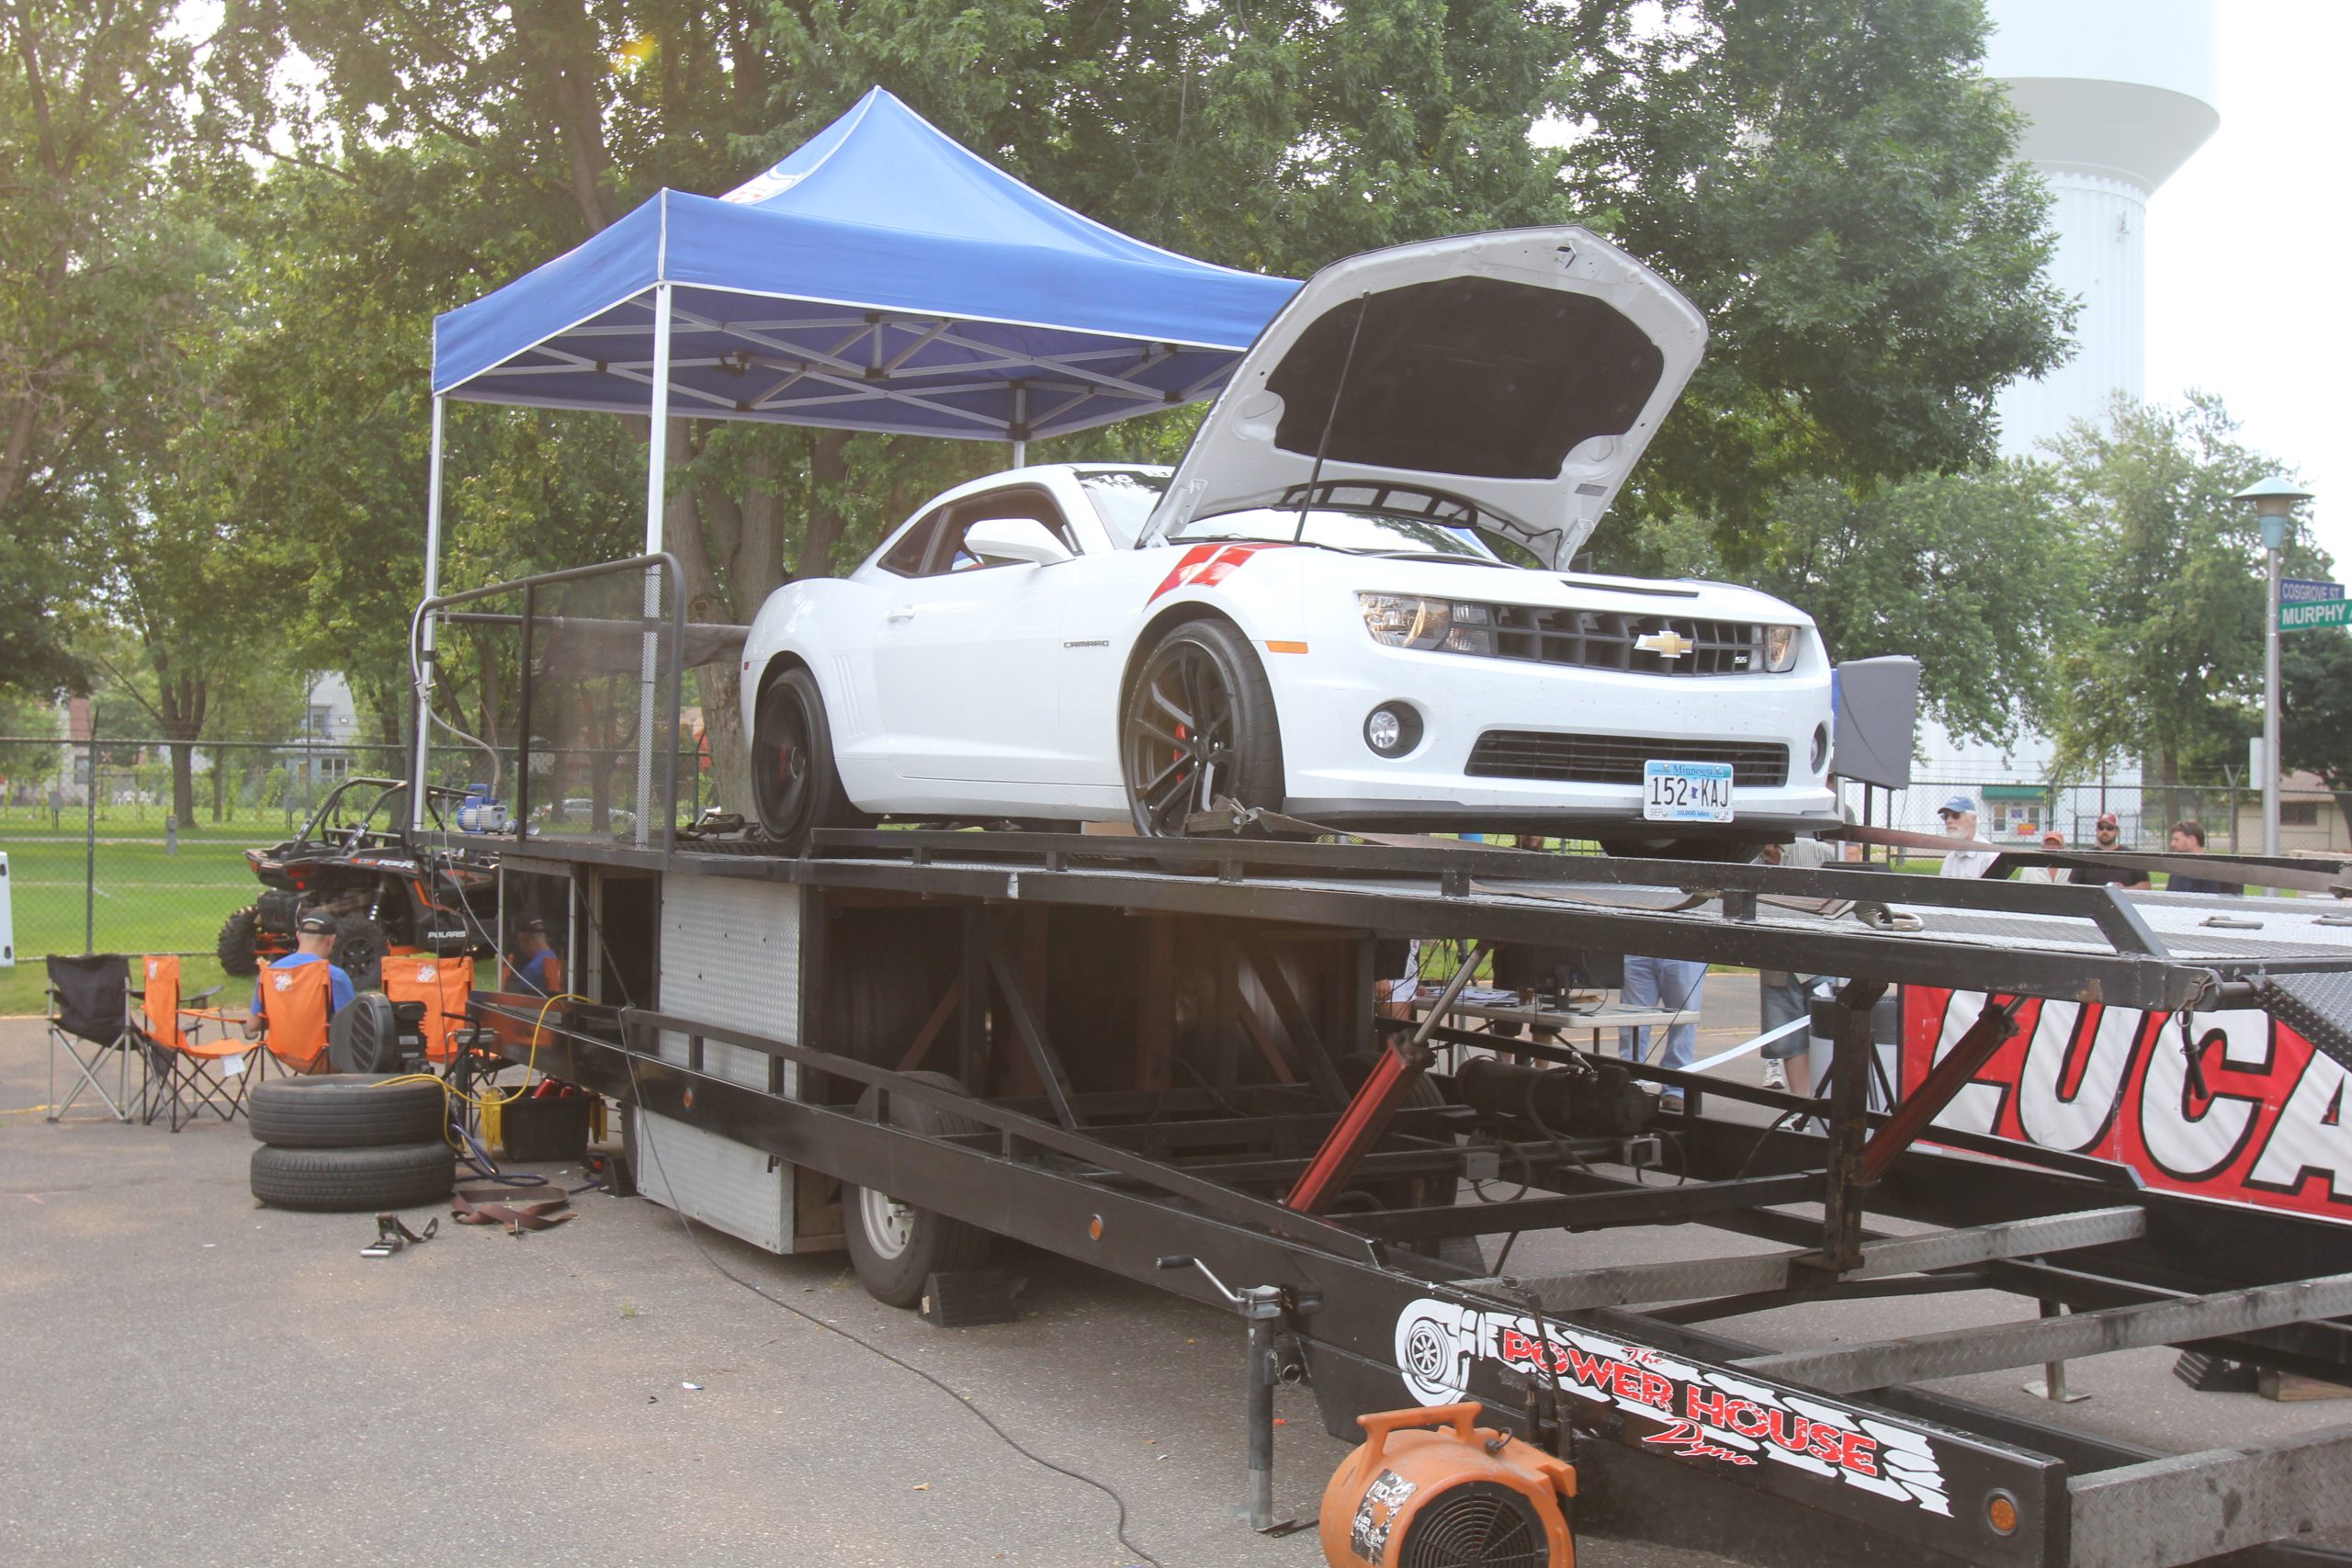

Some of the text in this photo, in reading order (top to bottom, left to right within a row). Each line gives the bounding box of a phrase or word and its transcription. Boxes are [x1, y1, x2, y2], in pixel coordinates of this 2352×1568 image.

[2282, 583, 2340, 601] COSGROVE ST
[2282, 604, 2346, 625] MURPHY
[1063, 640, 1110, 649] CAMARO
[1674, 764, 1713, 775] Minnesota
[1651, 776, 1728, 807] 152 KAJ
[427, 931, 467, 939] POLARIS
[1622, 1345, 1667, 1367] The
[1502, 1327, 1878, 1477] POWER HOUSE
[1642, 1416, 1758, 1466] Dyno
